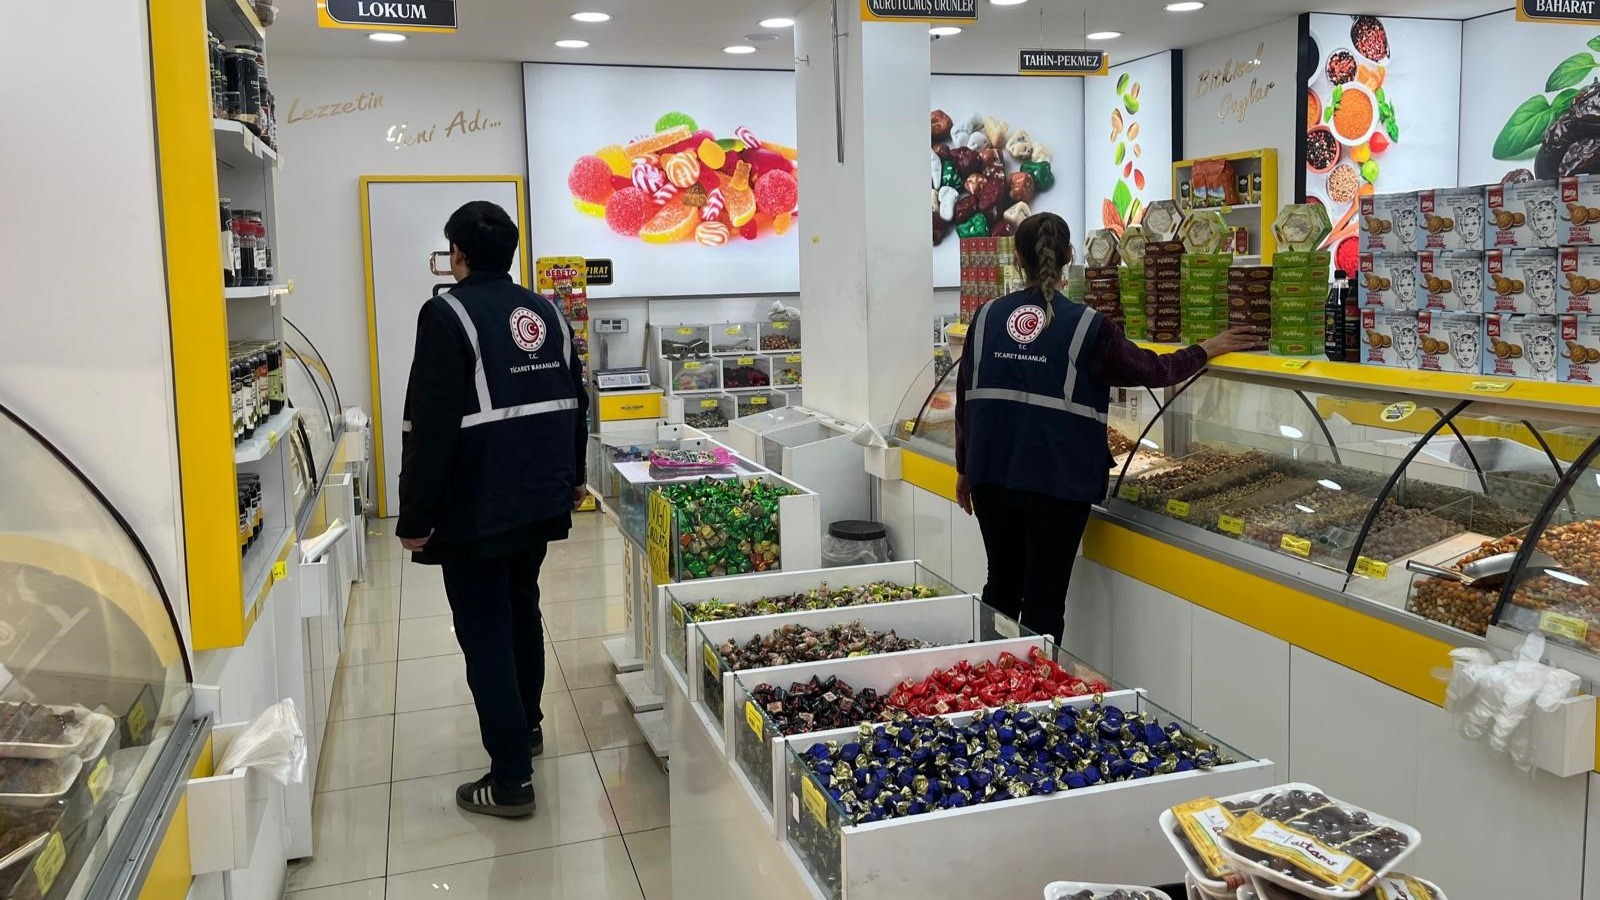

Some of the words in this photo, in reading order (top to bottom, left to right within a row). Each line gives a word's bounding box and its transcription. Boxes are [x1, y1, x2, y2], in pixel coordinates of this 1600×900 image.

[357, 1, 427, 19] LOKUM
[1536, 0, 1595, 14] BAHARAT
[1023, 52, 1099, 67] TAHİN-PEKMEZ
[287, 92, 384, 124] Lezzetin
[545, 269, 578, 278] BEBETO
[510, 364, 531, 374] TİCARET
